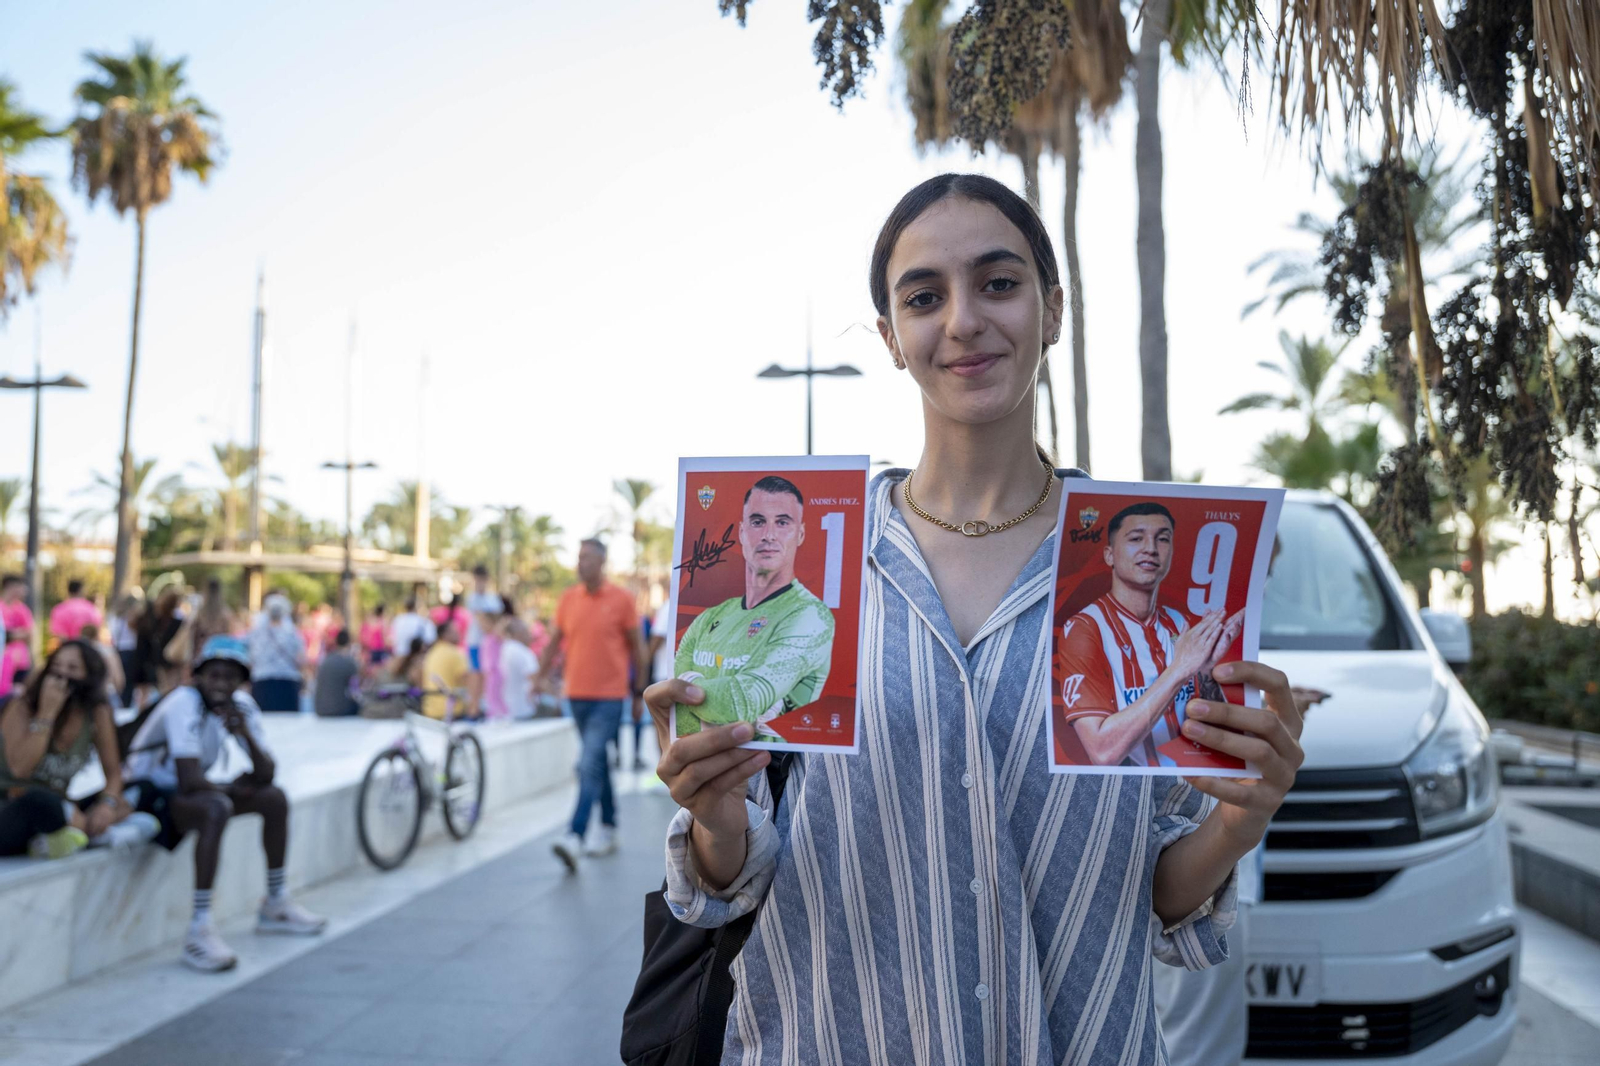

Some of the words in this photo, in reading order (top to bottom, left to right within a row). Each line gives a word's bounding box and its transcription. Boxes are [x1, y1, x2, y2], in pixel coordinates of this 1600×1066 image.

[820, 512, 845, 609] 1
[1204, 510, 1241, 521] THALYS
[1186, 521, 1238, 617] 9
